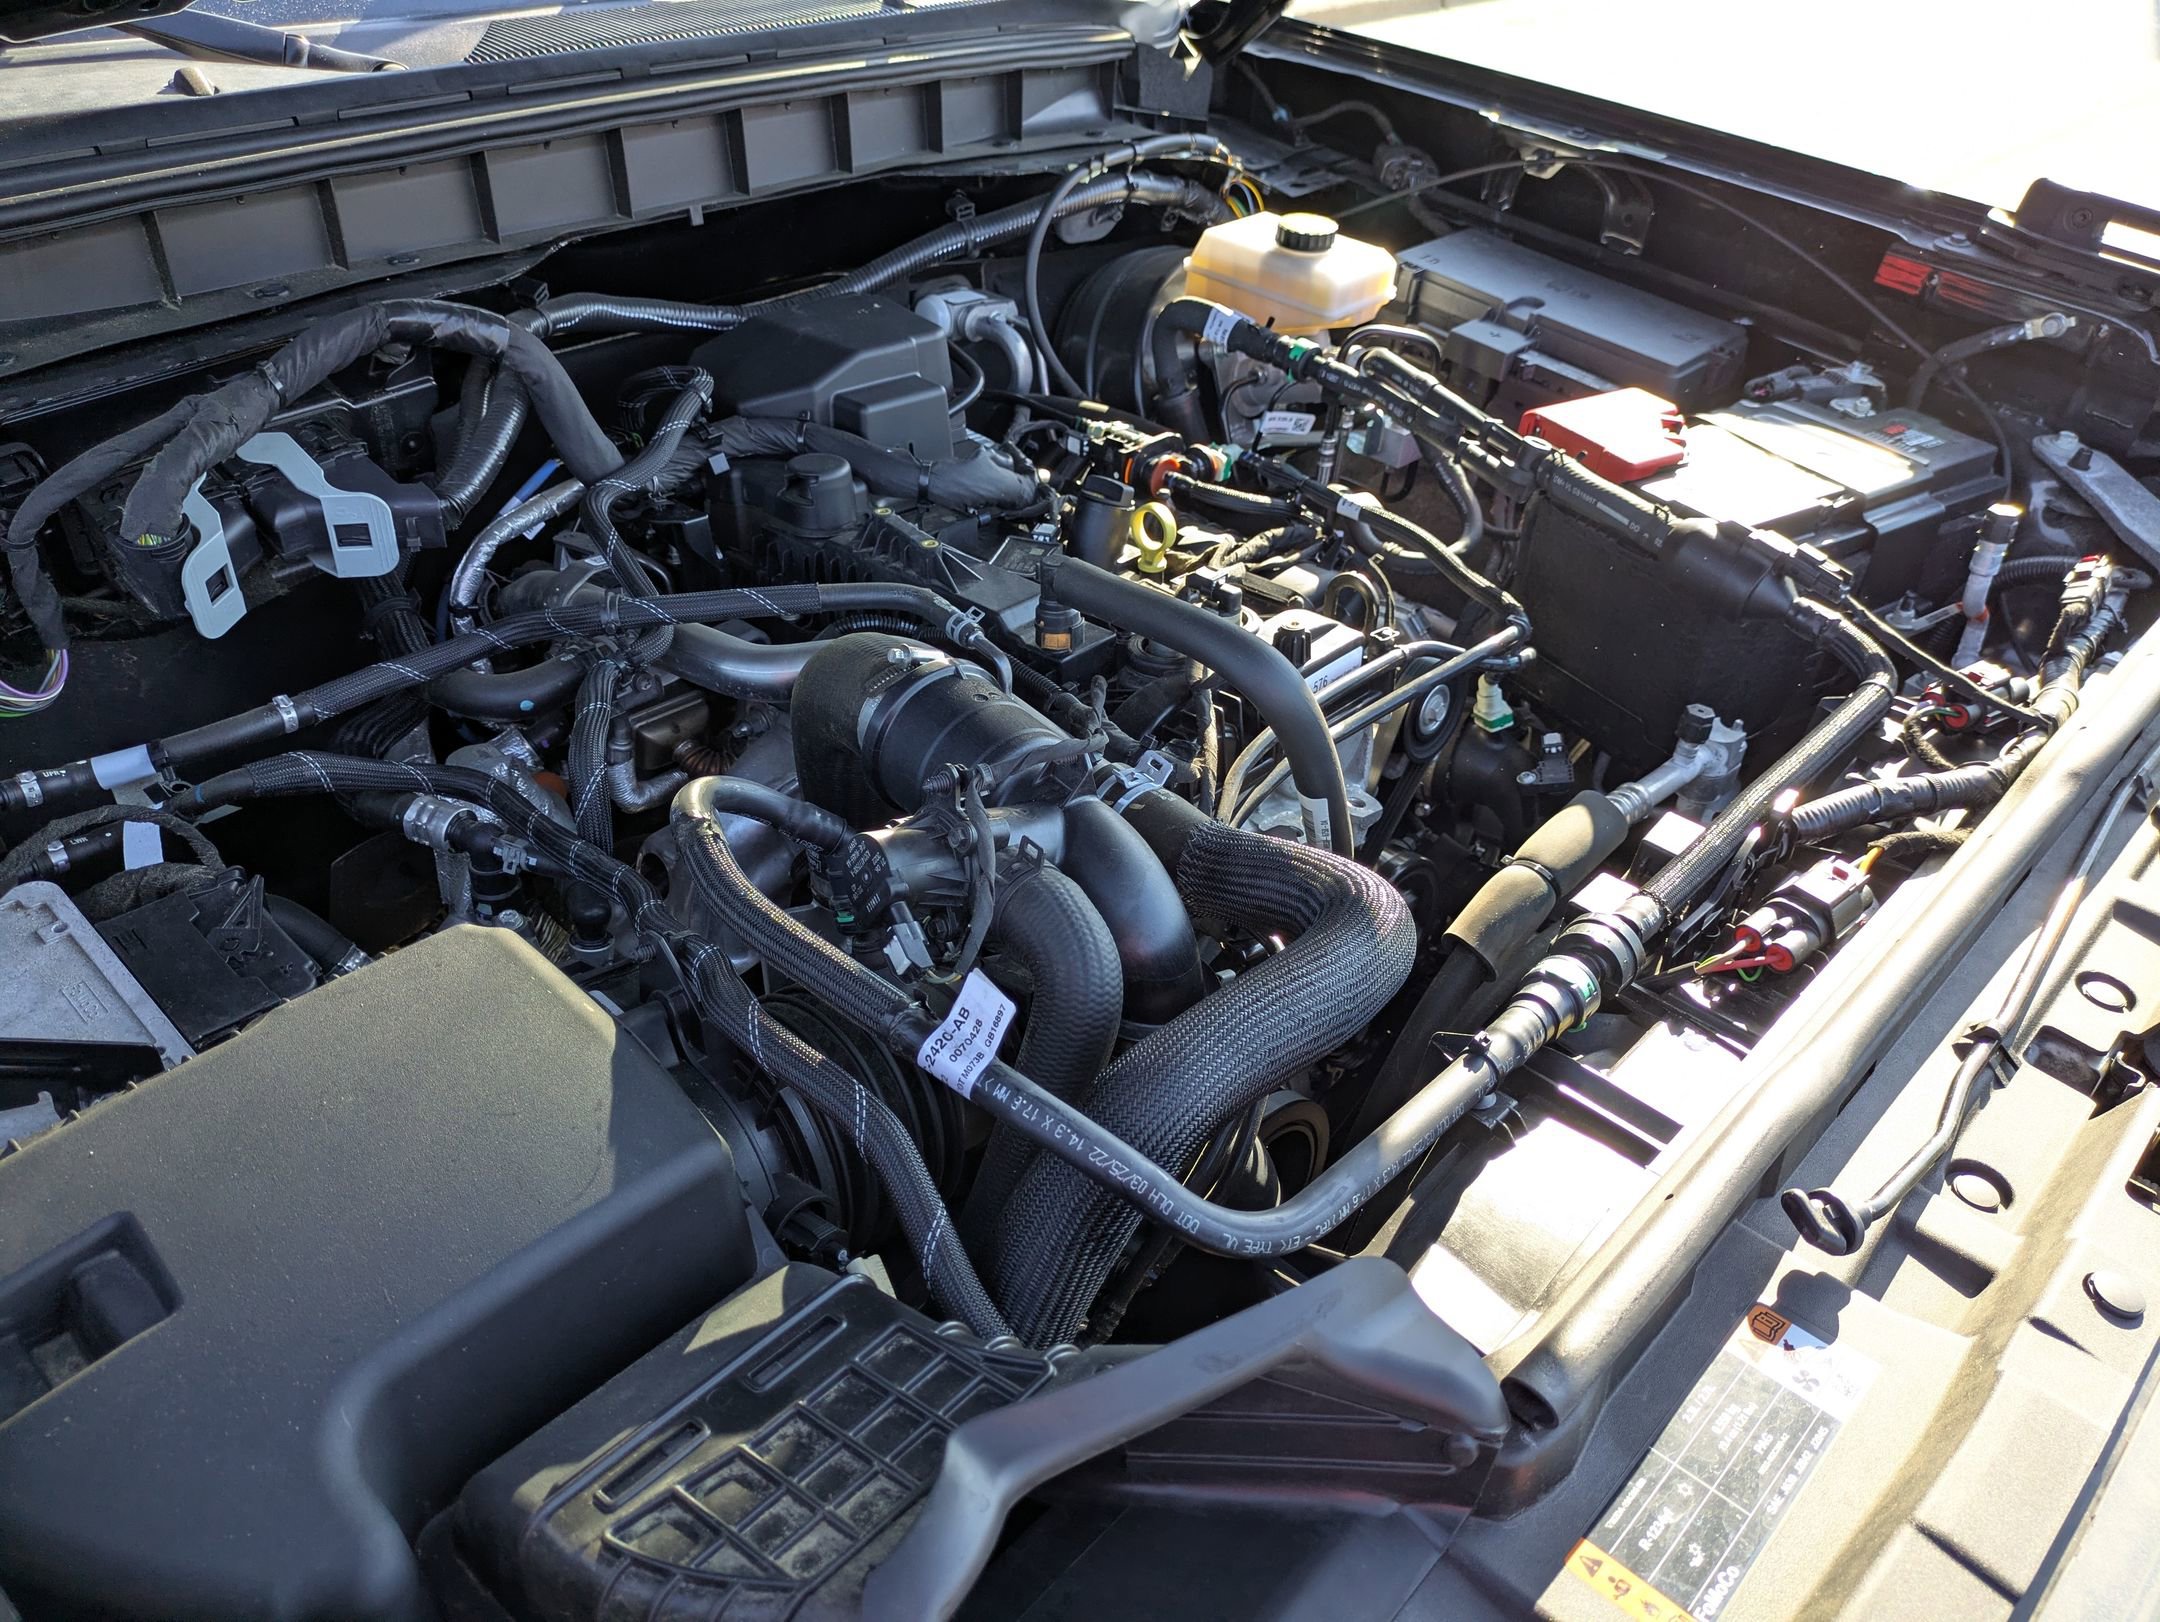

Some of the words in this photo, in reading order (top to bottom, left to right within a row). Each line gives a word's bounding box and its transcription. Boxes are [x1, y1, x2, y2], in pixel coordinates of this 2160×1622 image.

[923, 1006, 970, 1068] -2420-AB
[948, 1018, 983, 1062] 0070428
[961, 1050, 985, 1078] M073B
[984, 1003, 1007, 1047] GB16897
[990, 1081, 1012, 1103] MM
[1039, 1113, 1055, 1130] X
[1052, 1121, 1088, 1153] 14.3
[1086, 1144, 1150, 1194] 03/25/22
[1382, 1160, 1400, 1184] 14.3
[1145, 1186, 1176, 1215] DLH
[1173, 1207, 1202, 1234] DOT
[1241, 1238, 1273, 1254] TYPE
[1753, 1432, 1773, 1455] PAG
[1692, 1565, 1740, 1622] FoMoCo
[1766, 1494, 1785, 1515] SAE
